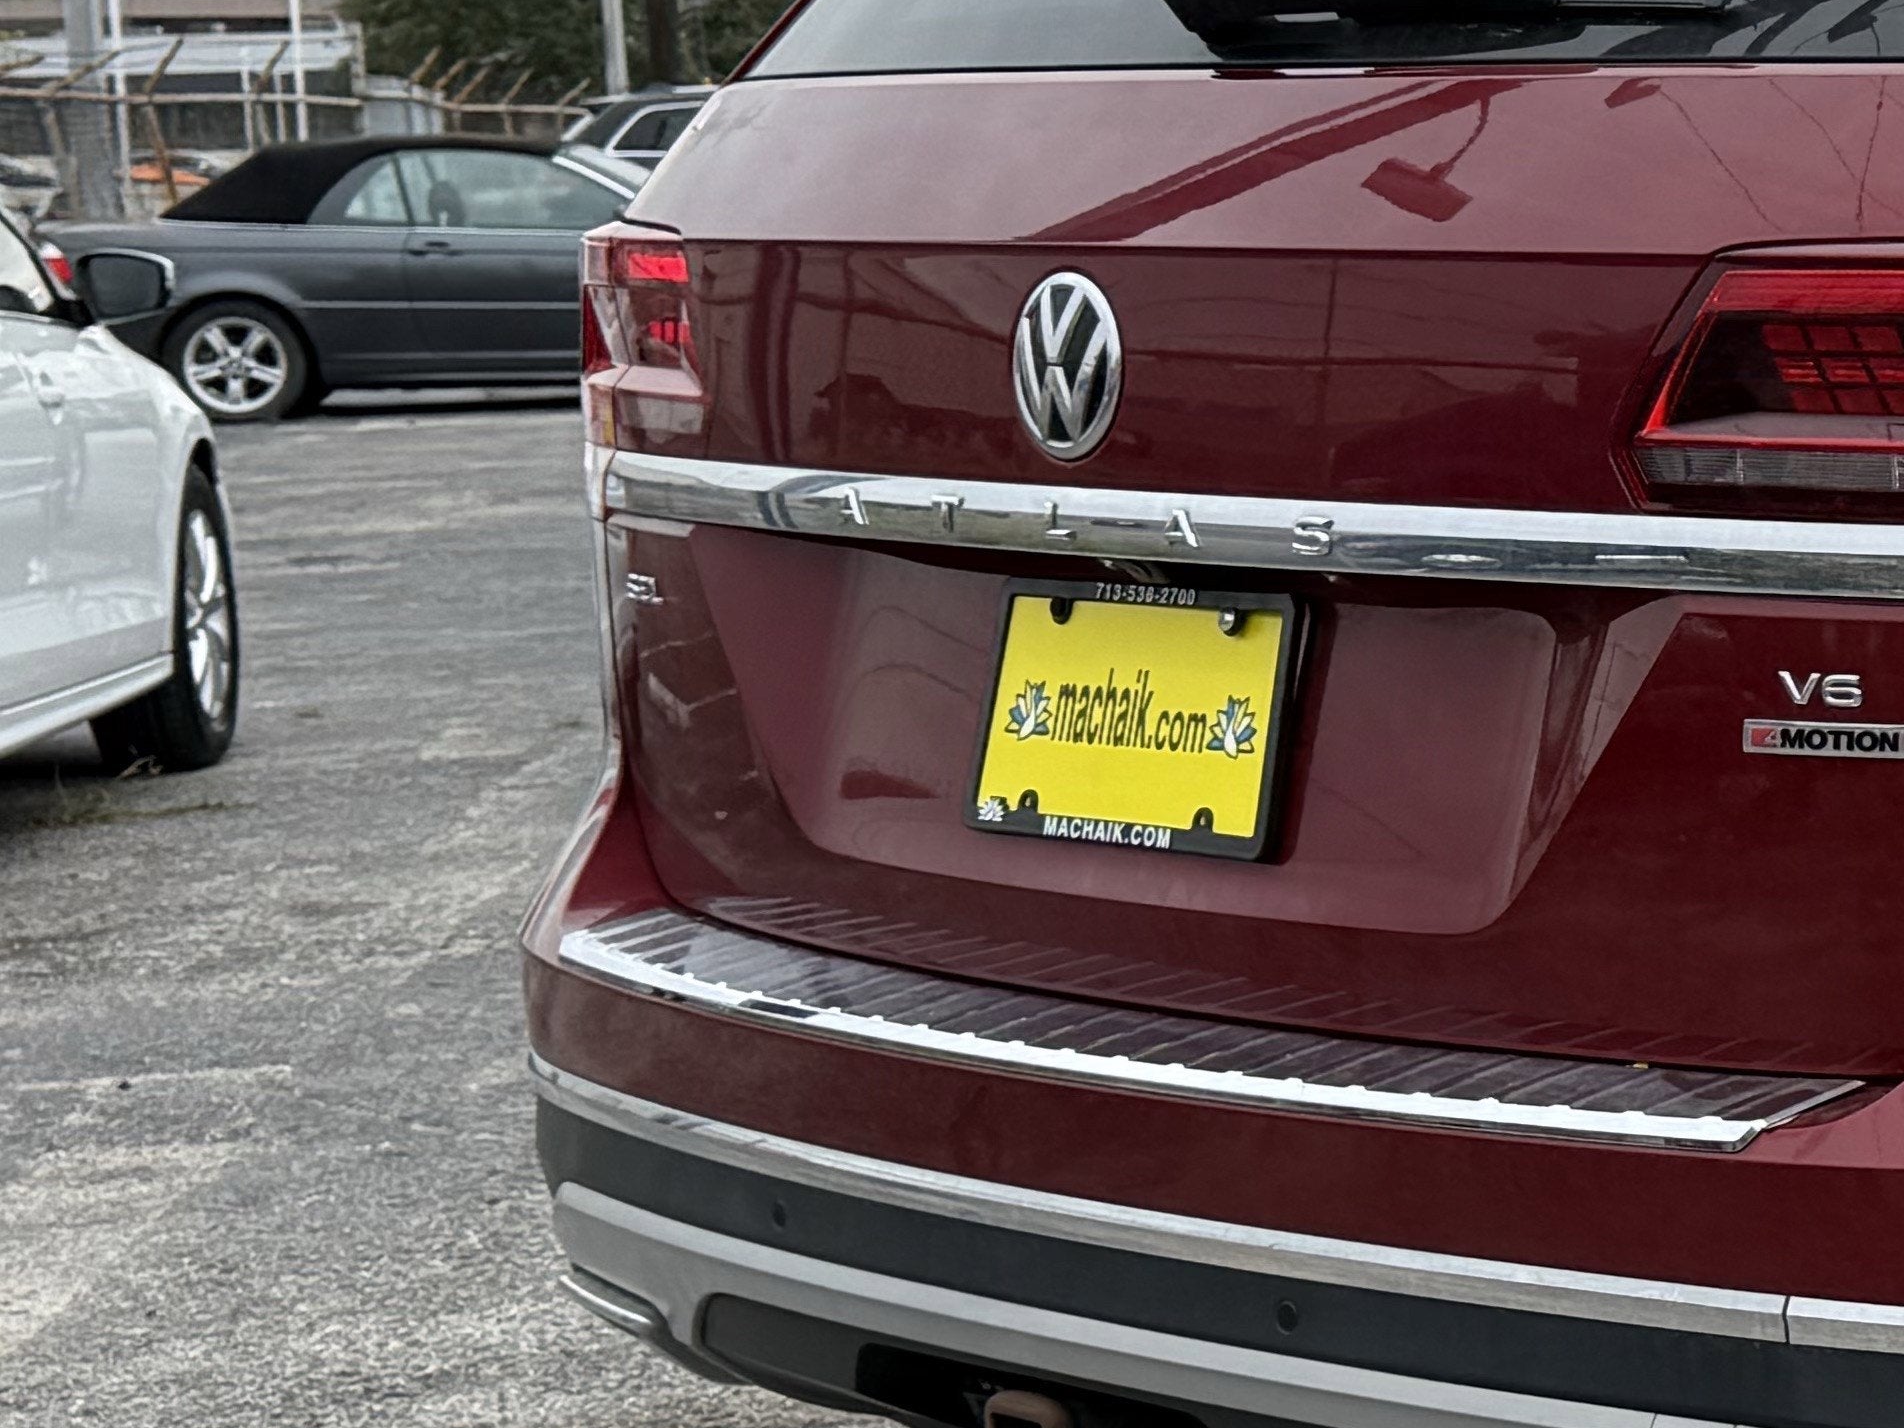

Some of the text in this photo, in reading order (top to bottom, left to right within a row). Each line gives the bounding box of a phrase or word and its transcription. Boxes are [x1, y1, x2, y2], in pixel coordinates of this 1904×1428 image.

[838, 487, 1335, 556] ATLAS
[1050, 668, 1207, 754] machaik.com
[1778, 671, 1863, 708] V6
[1043, 815, 1171, 850] MACHAIK.COM
